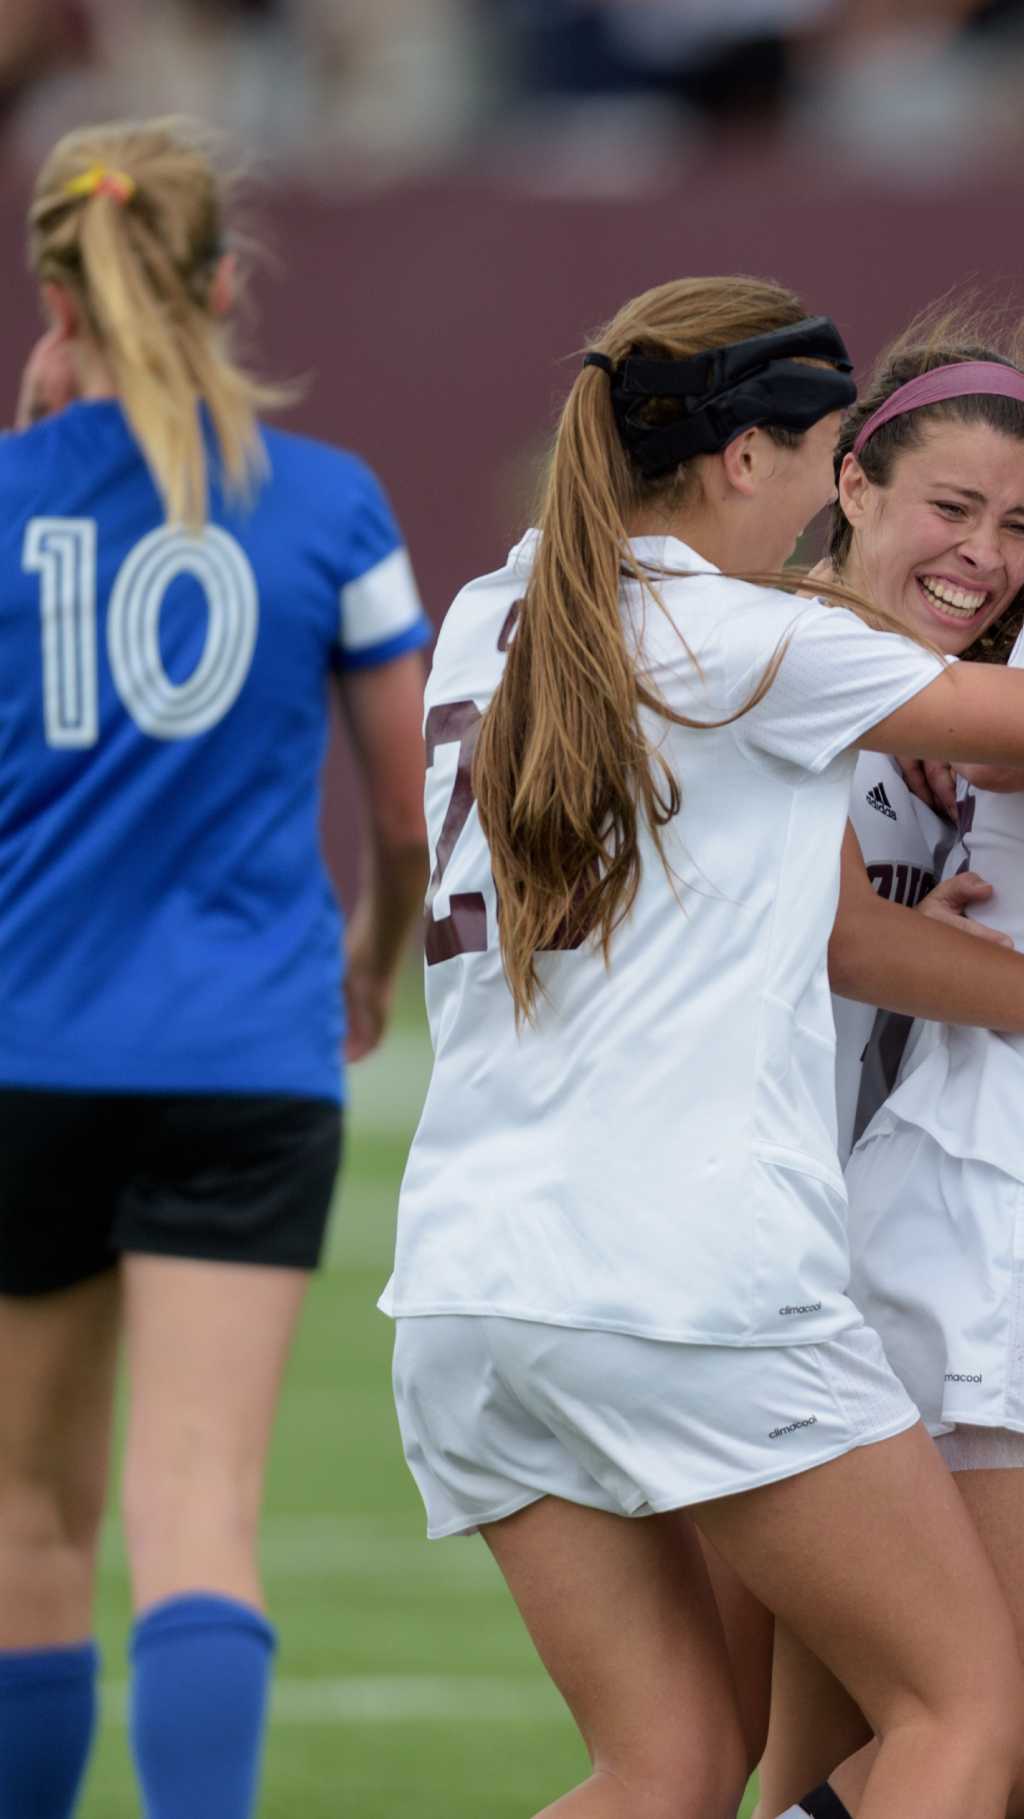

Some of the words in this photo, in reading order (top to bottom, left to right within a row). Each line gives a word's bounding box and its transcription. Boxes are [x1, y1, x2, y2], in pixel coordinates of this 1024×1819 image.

[22, 517, 260, 749] 10
[778, 1300, 822, 1316] climacool
[768, 1415, 818, 1439] climacool
